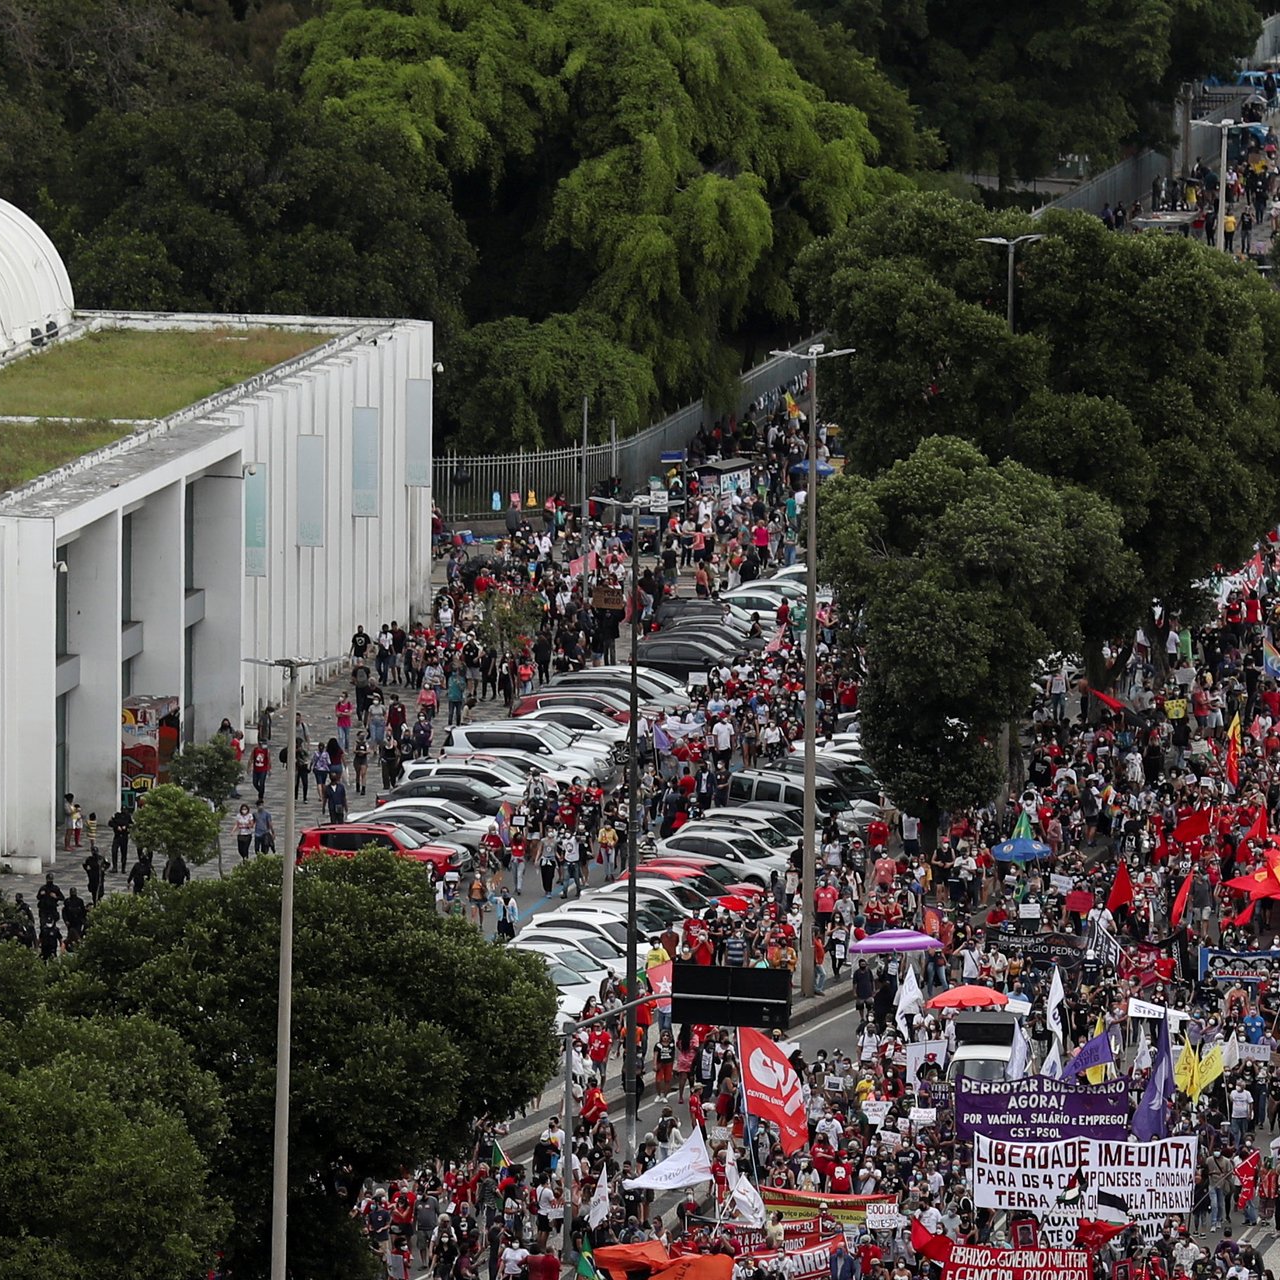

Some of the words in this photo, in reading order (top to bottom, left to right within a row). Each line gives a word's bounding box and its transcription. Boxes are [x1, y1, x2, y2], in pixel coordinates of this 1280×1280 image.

[961, 1078, 1039, 1095] DERROTAR
[1007, 1094, 1067, 1111] AGORA!
[963, 1113, 982, 1125] POR
[1030, 1110, 1070, 1126] SALÁRIO
[1078, 1112, 1128, 1129] EMPREGO!
[1009, 1127, 1062, 1139] CST-PSOL
[975, 1135, 1091, 1170] LIBERDADE
[1097, 1141, 1193, 1170] IMEDIATA
[976, 1166, 1017, 1188] PARA
[1022, 1173, 1040, 1188] OS
[1042, 1173, 1054, 1190] 4
[994, 1189, 1050, 1209] TERRA
[949, 1245, 991, 1268] ABAIXO
[996, 1250, 1047, 1269] GOVERNO
[1047, 1250, 1088, 1269] MILITAR
